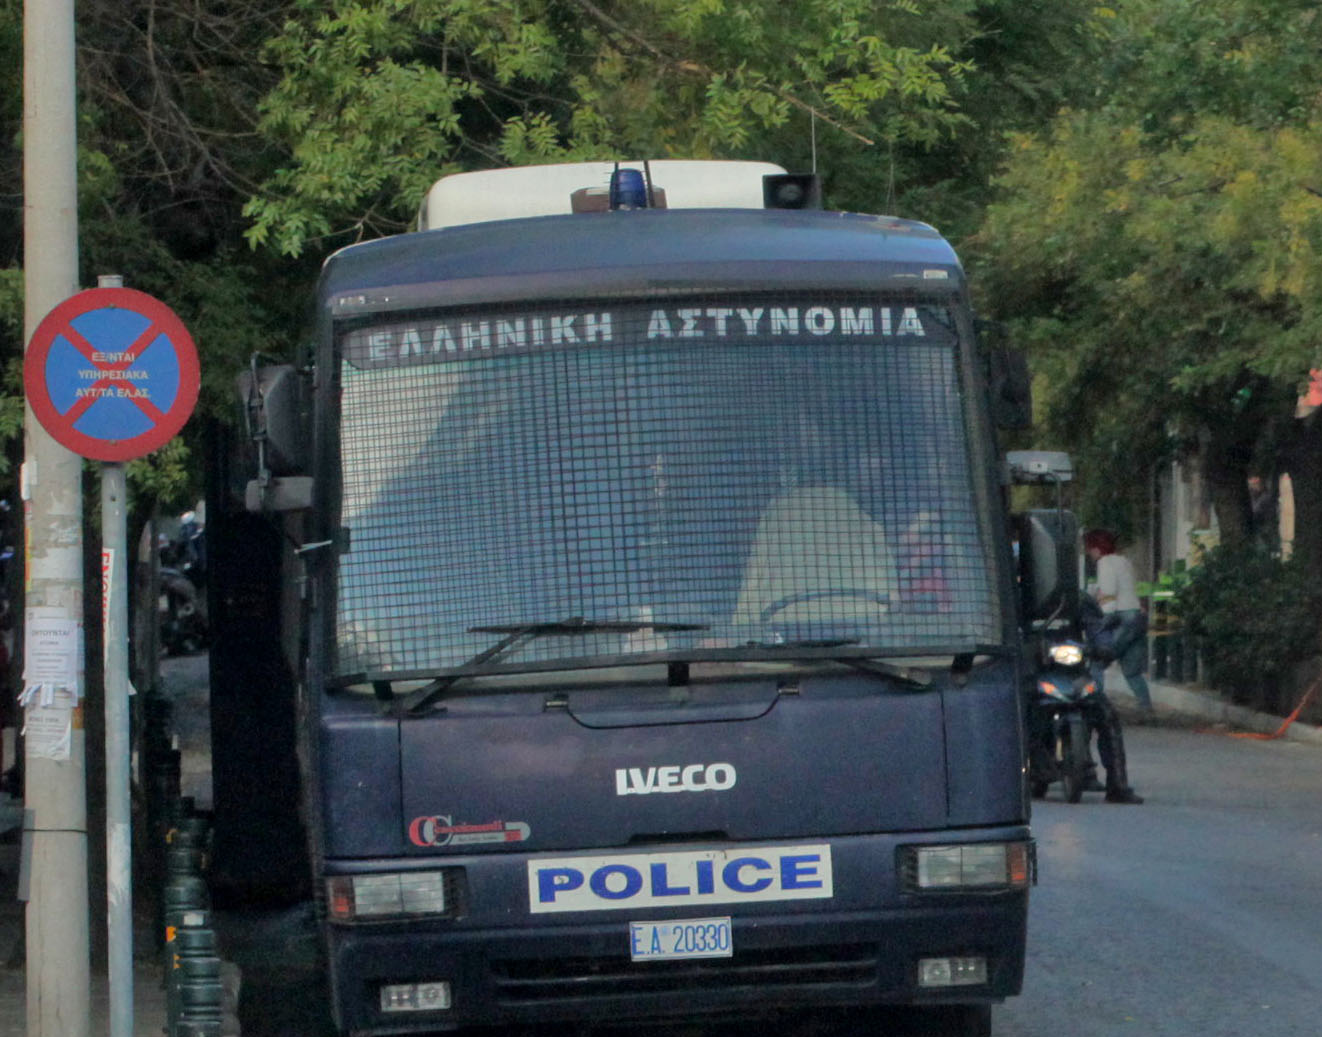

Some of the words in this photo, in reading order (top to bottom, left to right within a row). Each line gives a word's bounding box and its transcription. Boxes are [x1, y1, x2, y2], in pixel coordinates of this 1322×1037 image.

[368, 312, 613, 361] ΕΛΛΗΝΙΚΗ
[647, 306, 926, 338] ΑΣΤΥΝΟΜΙΑ
[615, 763, 737, 795] IVECO
[538, 854, 823, 904] POLICE
[672, 923, 729, 952] 20330
